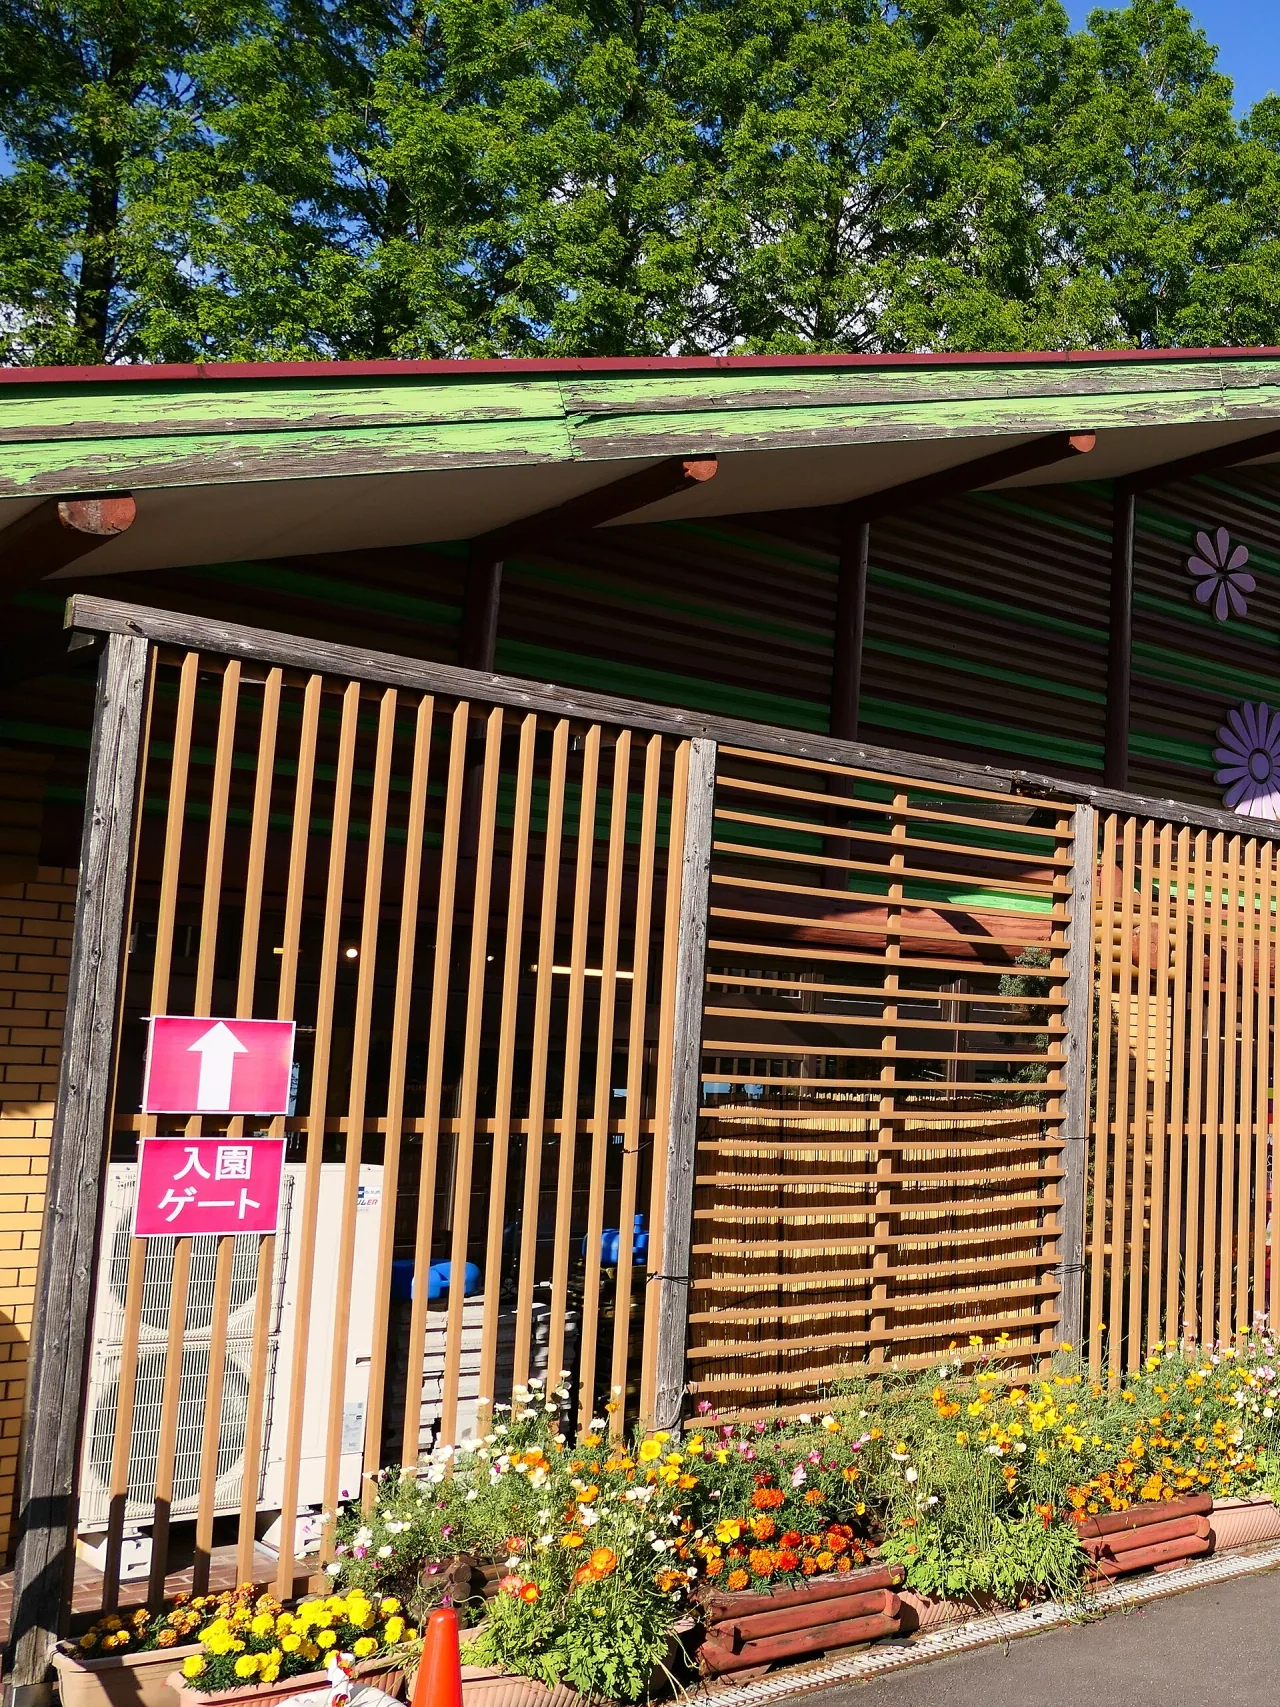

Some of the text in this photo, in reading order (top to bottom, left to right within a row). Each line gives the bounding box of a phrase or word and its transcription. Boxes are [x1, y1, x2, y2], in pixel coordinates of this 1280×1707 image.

[174, 1146, 253, 1180] 入園
[157, 1186, 261, 1223] ゲート
